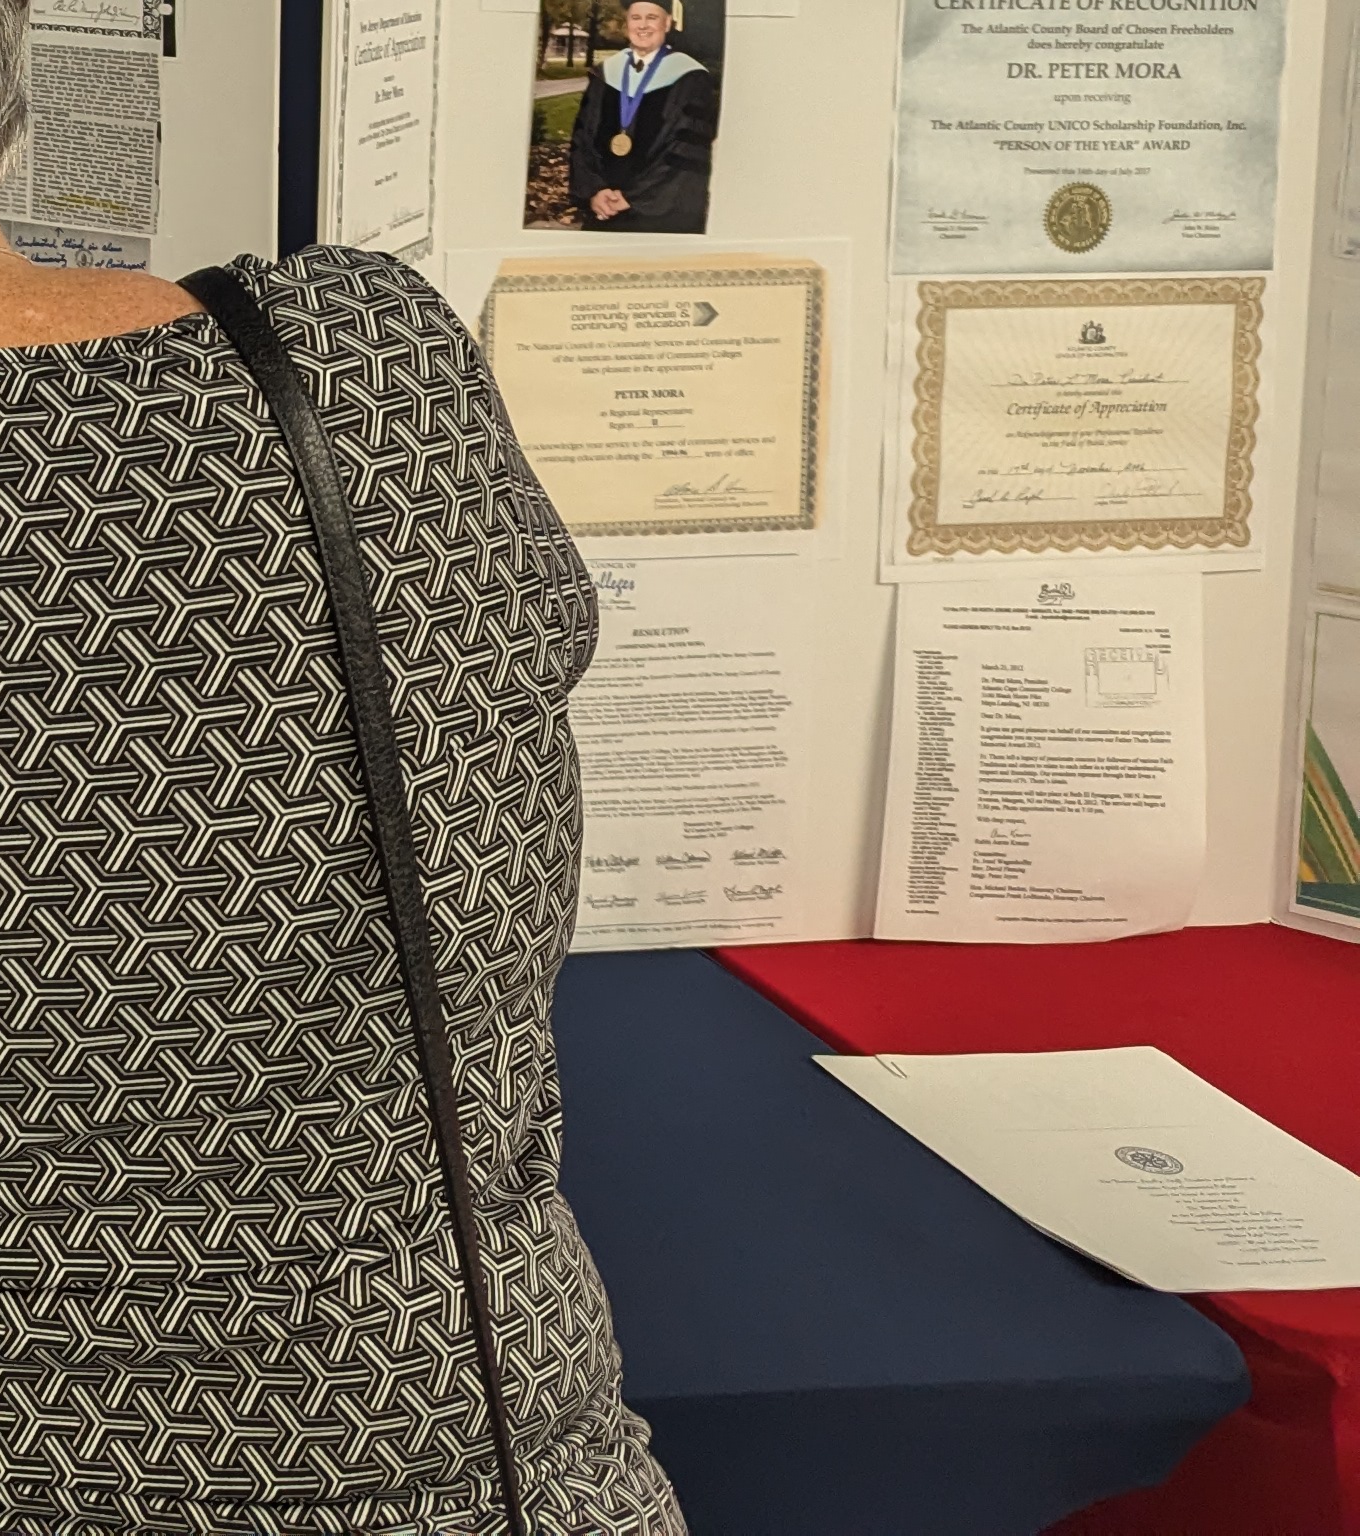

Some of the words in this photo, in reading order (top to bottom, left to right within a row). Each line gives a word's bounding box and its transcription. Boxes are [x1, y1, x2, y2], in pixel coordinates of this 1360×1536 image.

[961, 24, 983, 35] The
[986, 24, 1030, 35] Atlantic
[1031, 24, 1073, 37] County
[1075, 24, 1109, 35] Board
[1111, 24, 1123, 35] of
[1125, 24, 1168, 35] Chosen
[1170, 25, 1235, 36] Freeholders
[1006, 63, 1043, 80] DR.
[1047, 63, 1108, 79] PETER
[1114, 63, 1182, 80] MORA
[1007, 401, 1071, 419] Certificate
[1074, 400, 1088, 419] of
[1089, 400, 1167, 419] Appreciation
